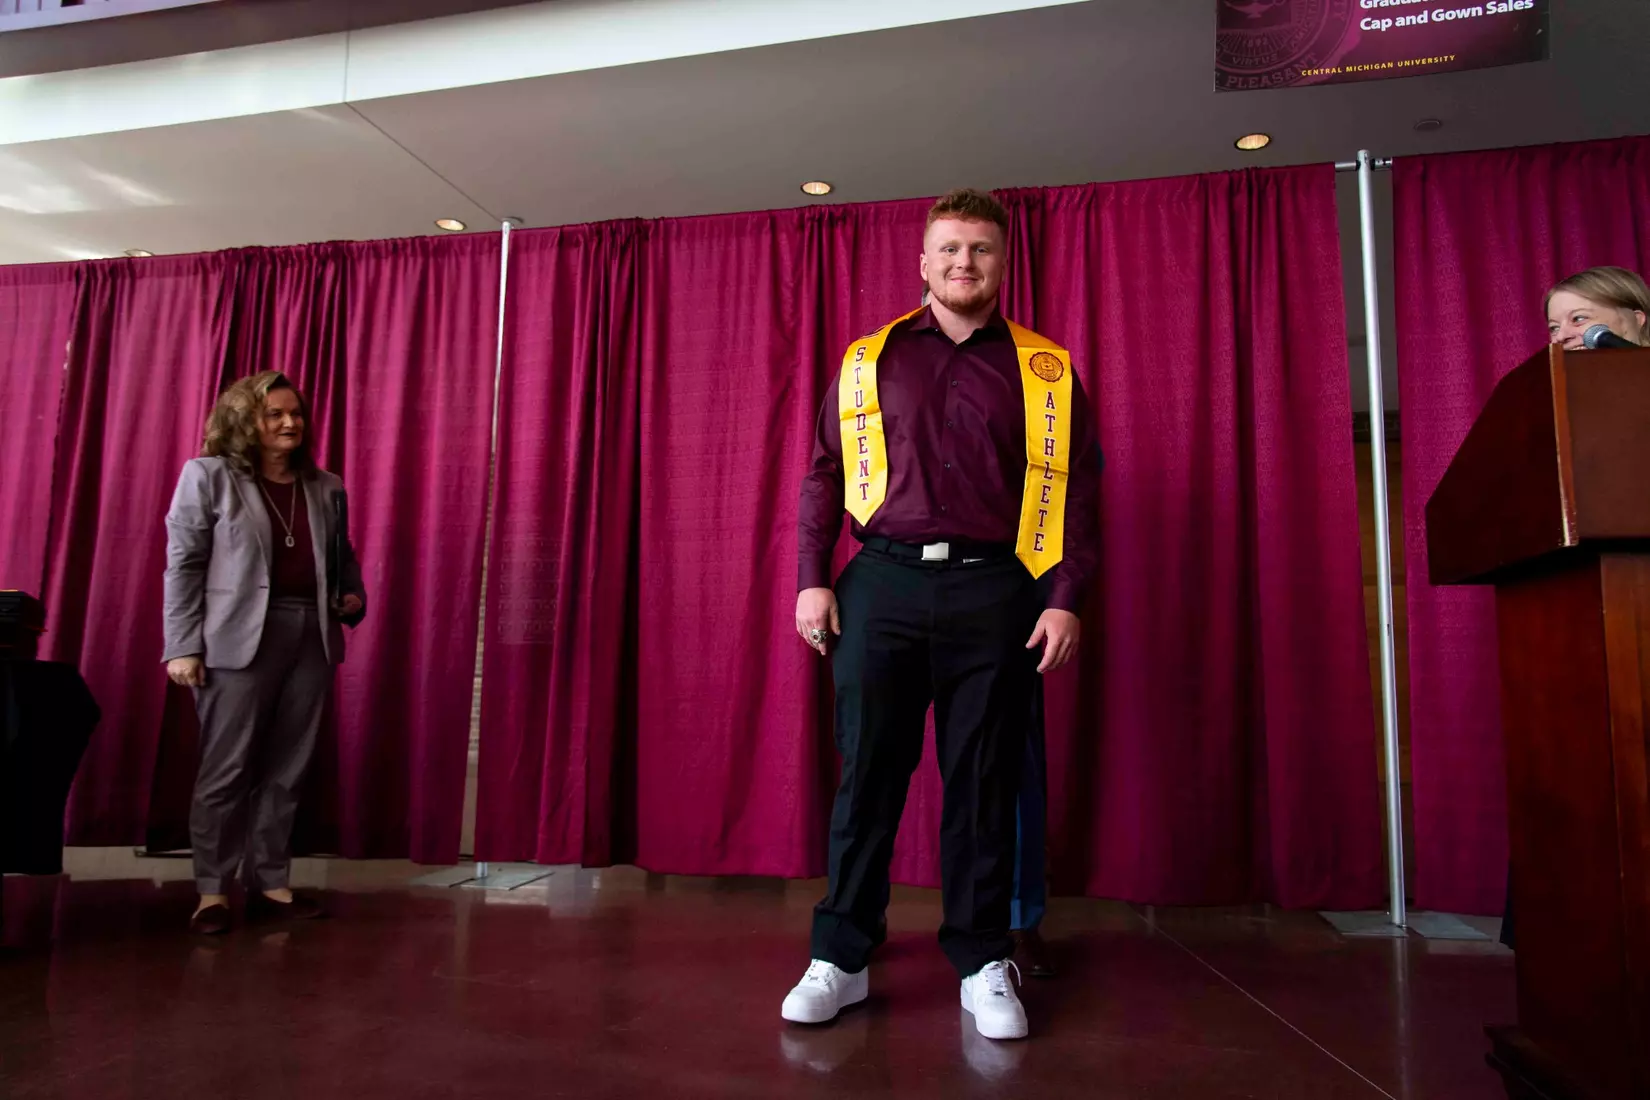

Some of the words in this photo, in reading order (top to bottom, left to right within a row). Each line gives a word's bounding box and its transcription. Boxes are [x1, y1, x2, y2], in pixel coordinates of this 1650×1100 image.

[1360, 17, 1393, 31] Cap
[1395, 10, 1428, 26] and
[1431, 6, 1483, 22] Gown
[1486, 0, 1534, 15] Sales
[1225, 52, 1318, 89] PLEASANT
[1301, 67, 1343, 77] CENTRAL
[1345, 62, 1394, 73] MICHIGAN
[1397, 55, 1456, 67] UNIVERSITY
[855, 346, 869, 501] STUDENT
[1033, 391, 1056, 552] ATHLETE
